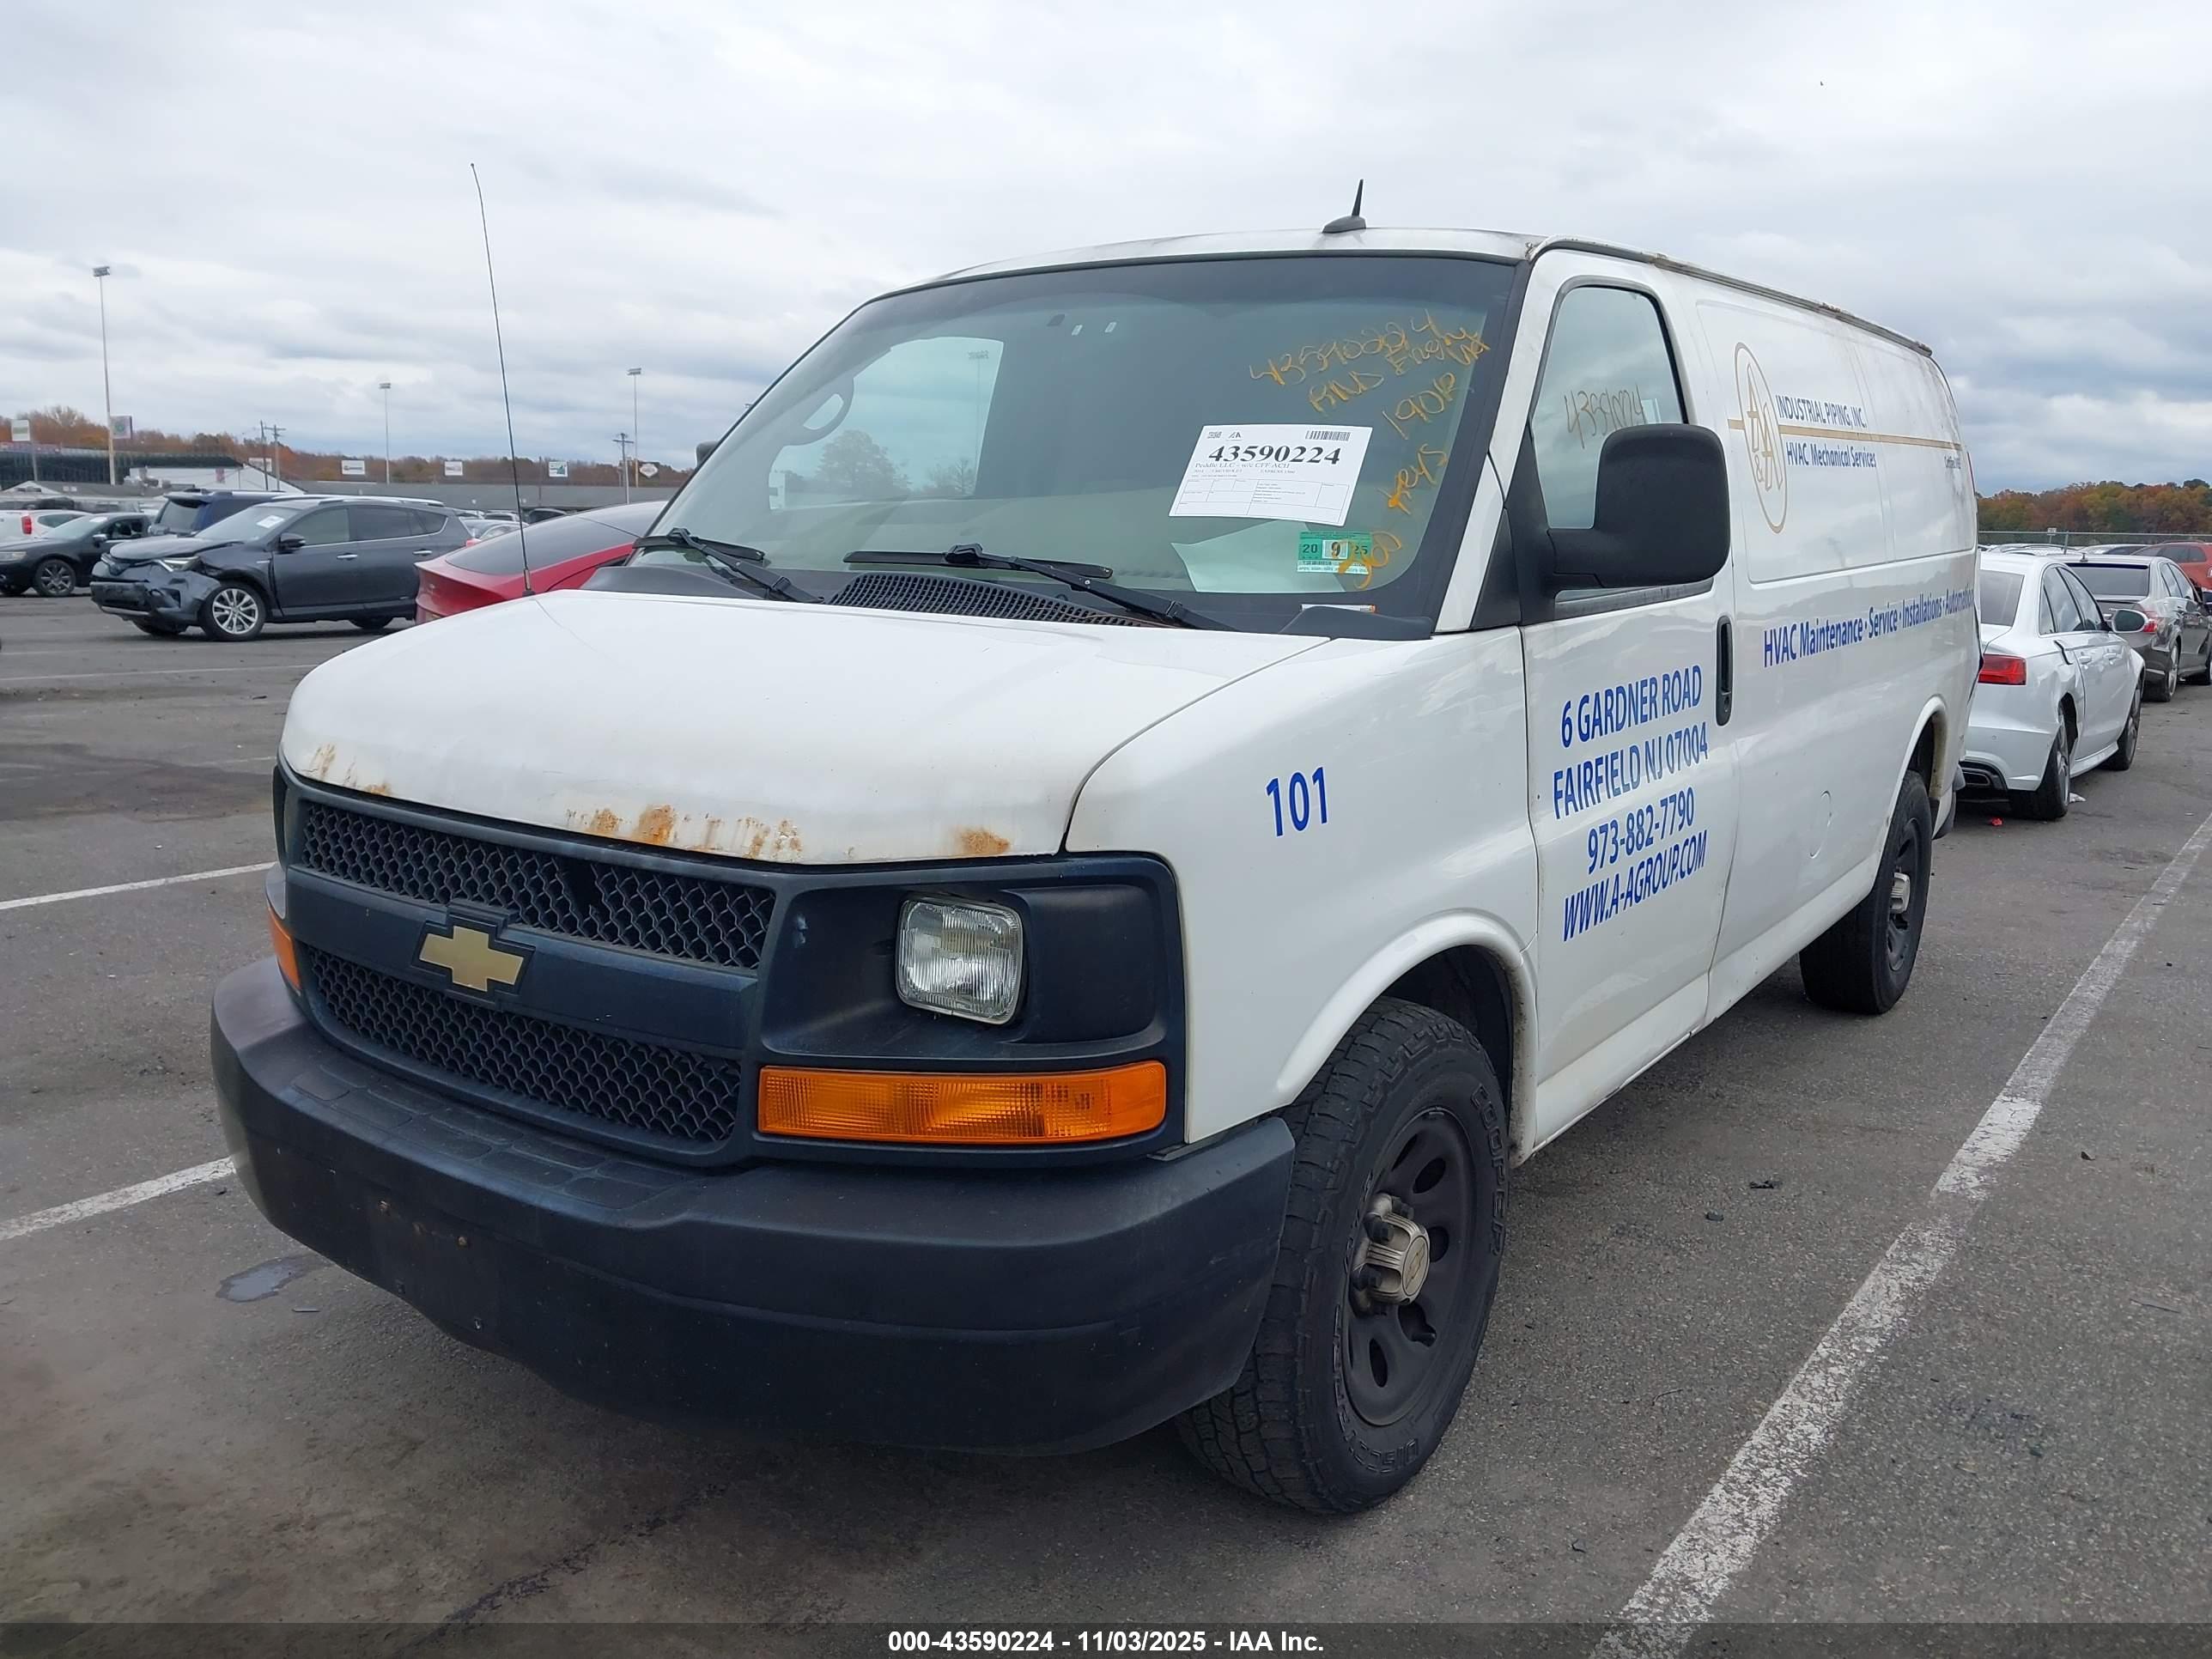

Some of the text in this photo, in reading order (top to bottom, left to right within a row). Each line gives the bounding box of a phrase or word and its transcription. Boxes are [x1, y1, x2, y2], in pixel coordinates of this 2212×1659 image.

[1775, 394, 1868, 428] INDUSTRIAL PIPING, INC.
[1208, 445, 1341, 465] 43590224
[1785, 441, 1877, 468] HVAC Mechanical Services
[1303, 544, 1318, 554] 20
[1331, 541, 1341, 556] 9
[1763, 623, 1797, 667] HVAC
[1800, 617, 1863, 658] Maintenance
[1869, 603, 1898, 638] Service
[1902, 592, 1943, 628] Installations
[1562, 665, 1702, 748] 6 GARDNER ROAD
[1266, 766, 1328, 837] 101
[1553, 721, 1708, 819] FAIRFIELD NJ 07004
[1588, 787, 1694, 874] 973-882-7790
[1563, 830, 1707, 942] WWW.A-AGROUP.COM
[1470, 1083, 1507, 1257] COOPER
